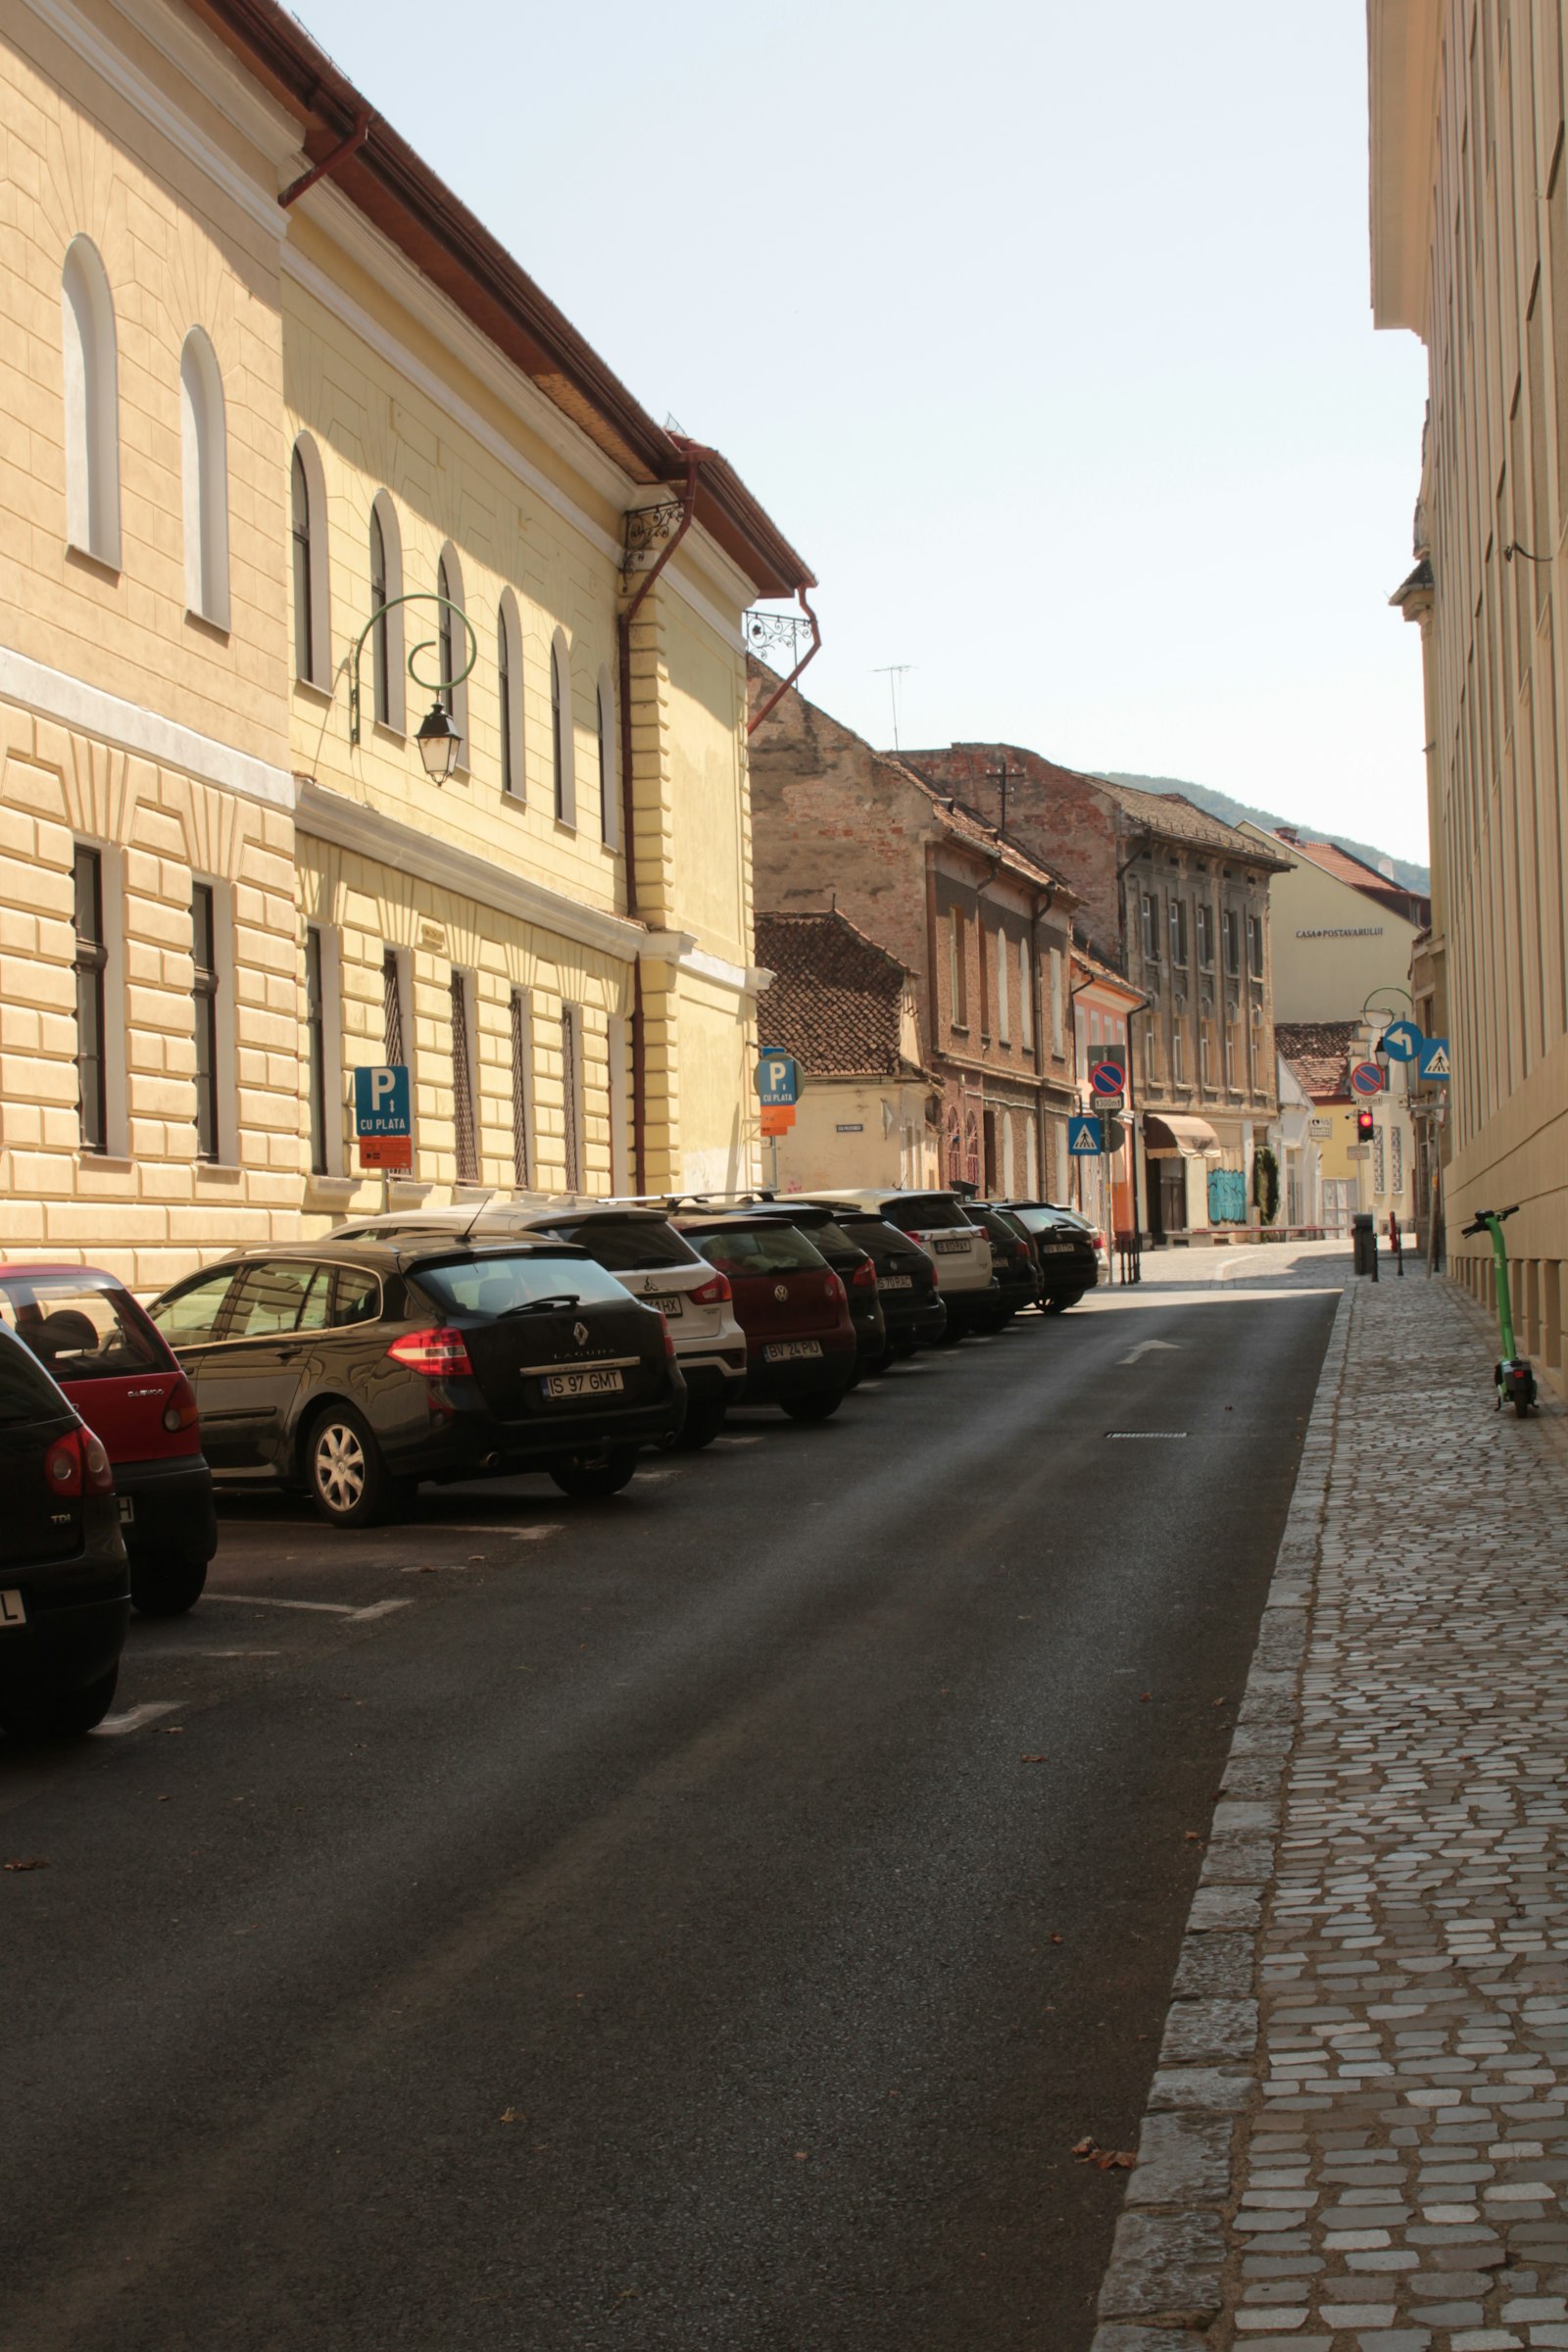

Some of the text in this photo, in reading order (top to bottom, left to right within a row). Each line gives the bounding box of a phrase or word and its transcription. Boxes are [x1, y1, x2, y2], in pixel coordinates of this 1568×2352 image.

[769, 1062, 786, 1091] P
[371, 1068, 396, 1110] P
[360, 1118, 405, 1130] CU PLATA
[768, 1345, 784, 1358] BV
[788, 1343, 801, 1355] 24
[550, 1372, 618, 1395] IS 97 GMT
